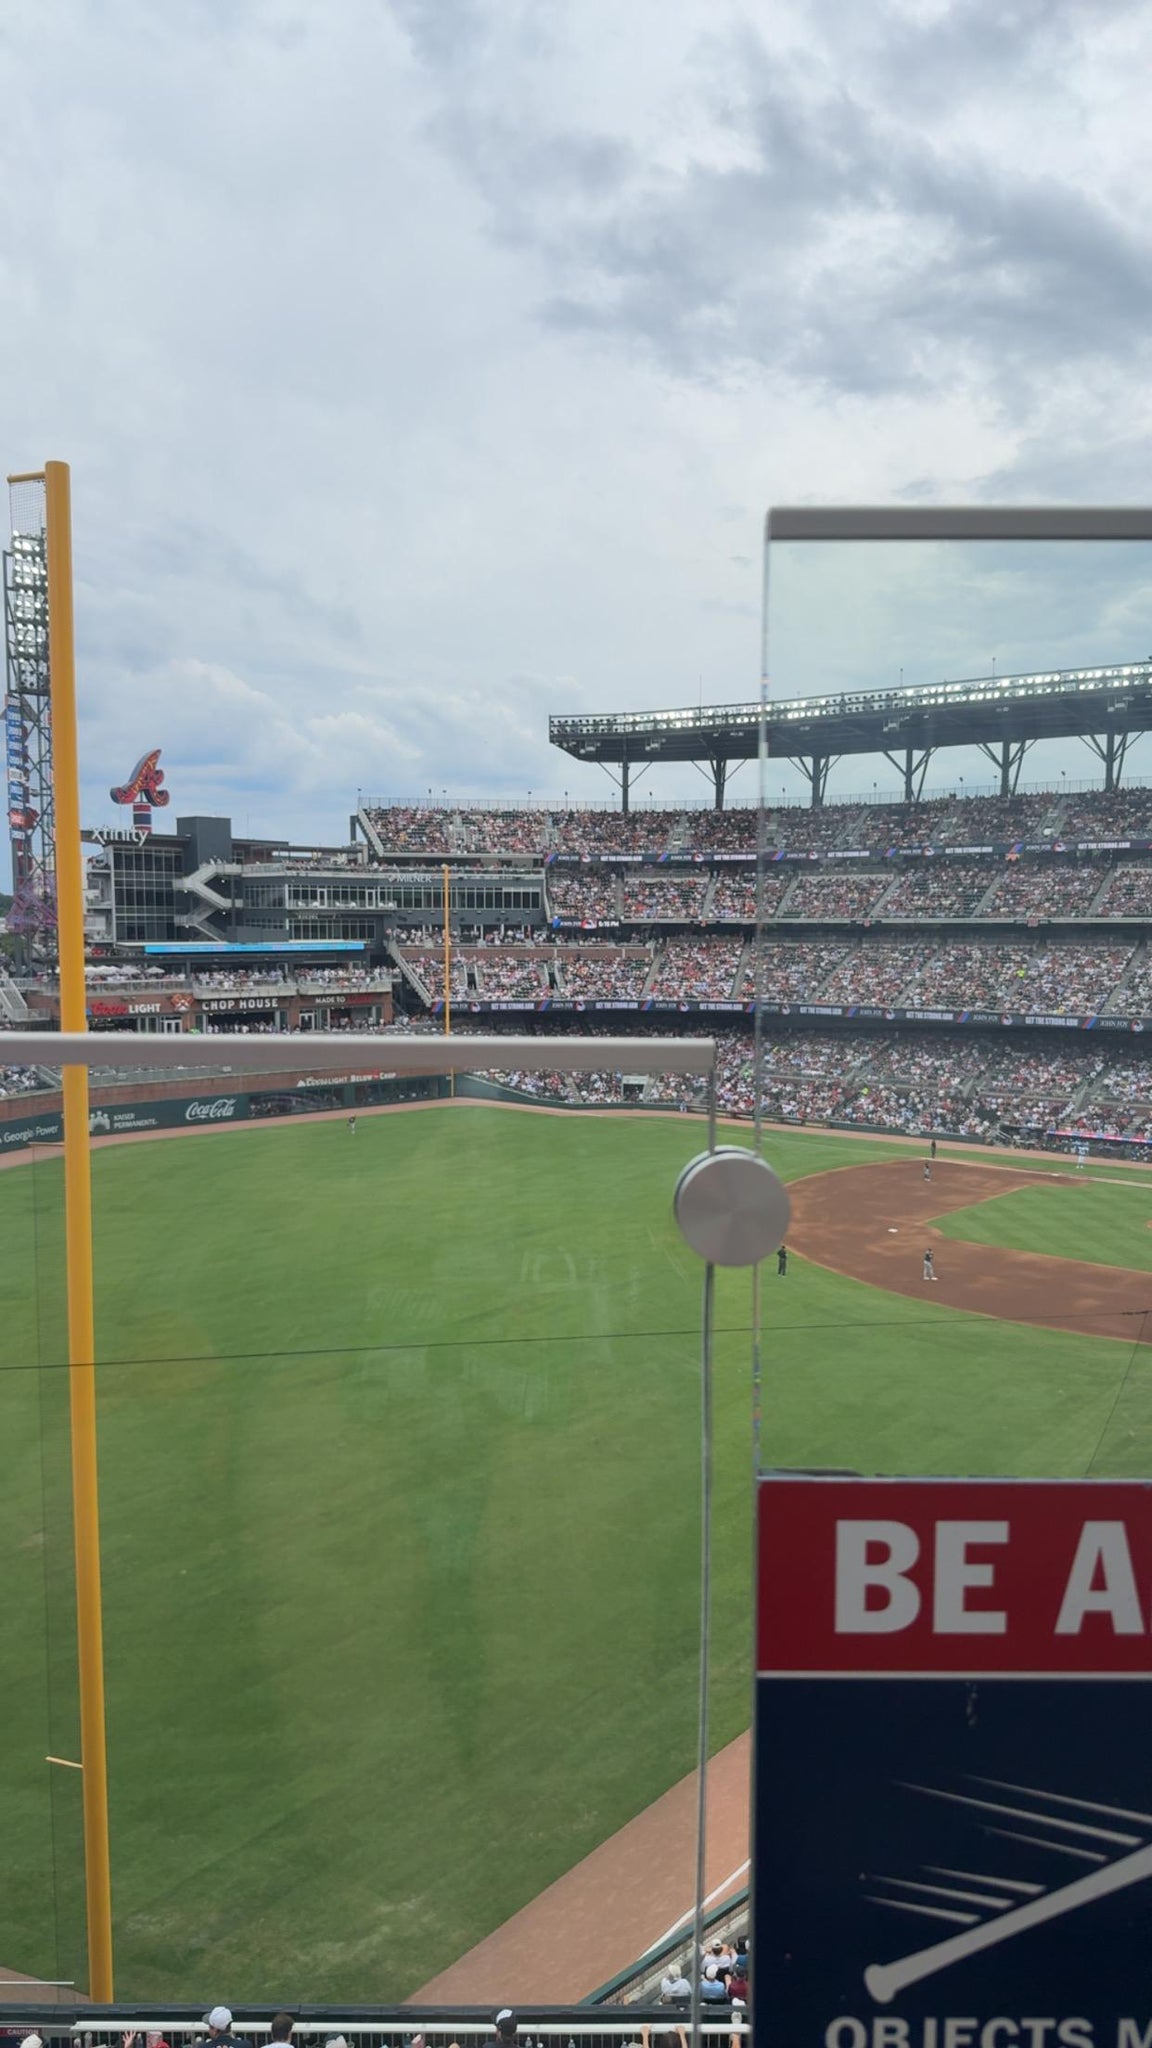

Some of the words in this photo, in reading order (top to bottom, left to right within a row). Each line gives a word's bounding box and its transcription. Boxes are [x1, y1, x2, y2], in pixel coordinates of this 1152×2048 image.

[92, 827, 149, 847] xfinity
[202, 1000, 235, 1011] CHOP
[240, 998, 279, 1009] HOUSE
[315, 996, 335, 1004] MADE
[128, 1003, 161, 1014] LIGHT
[114, 1113, 135, 1121] KAISER
[186, 1099, 237, 1120] Coca-Cola
[4, 1129, 34, 1143] Georgia
[36, 1125, 59, 1136] Power
[835, 1519, 1010, 1634] BE
[1054, 1520, 1152, 1635] A
